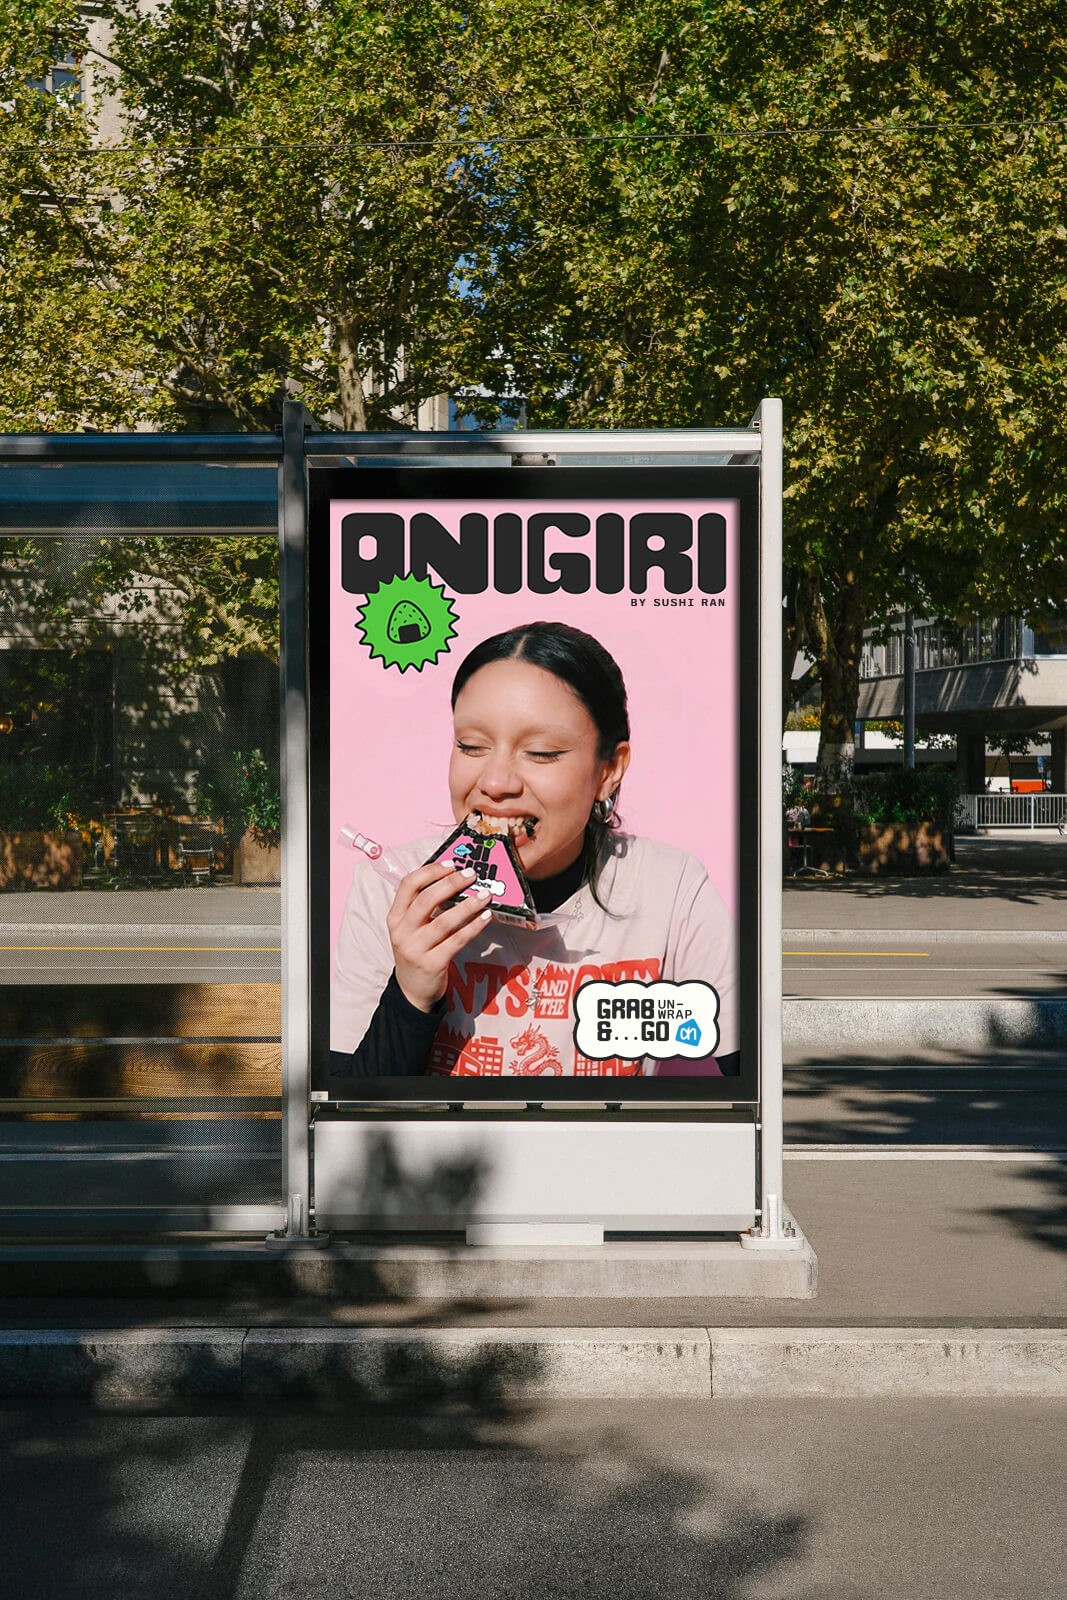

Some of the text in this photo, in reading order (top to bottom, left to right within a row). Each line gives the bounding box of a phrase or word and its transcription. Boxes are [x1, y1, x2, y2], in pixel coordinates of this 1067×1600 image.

[341, 512, 727, 594] ONIGIRI
[630, 598, 726, 607] BY SUSHI RAN
[540, 981, 567, 995] AND
[539, 999, 566, 1016] THE
[597, 998, 655, 1020] GRAB
[658, 1000, 684, 1009] UN-
[657, 1010, 692, 1019] WRAP
